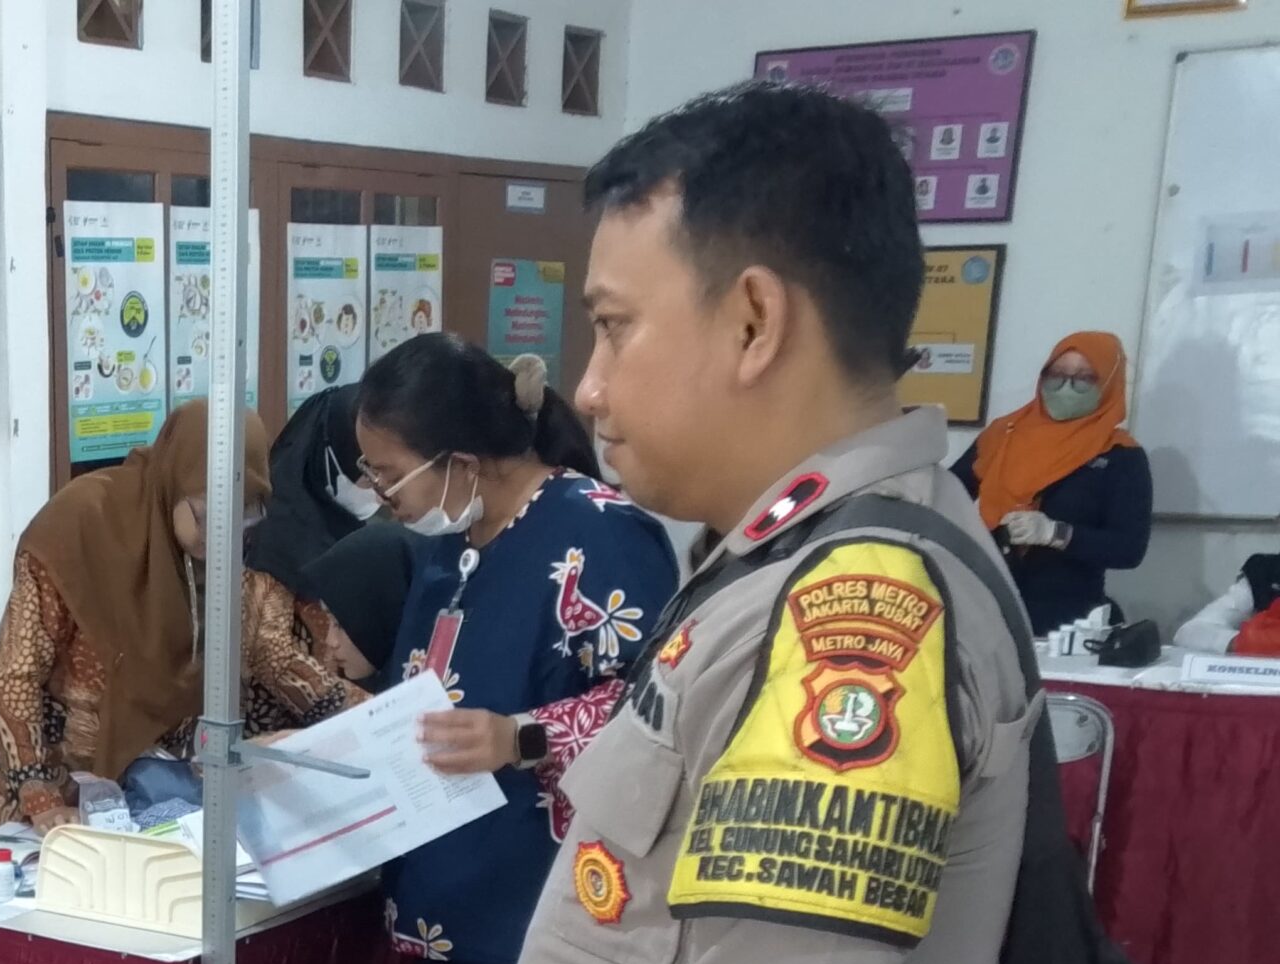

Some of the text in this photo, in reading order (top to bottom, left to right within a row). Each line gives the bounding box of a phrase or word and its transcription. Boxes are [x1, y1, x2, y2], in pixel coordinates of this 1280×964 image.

[799, 580, 929, 617] POLRES METRO
[803, 599, 924, 631] JAKARTA PUSAT
[811, 635, 906, 661] METRO JAYA
